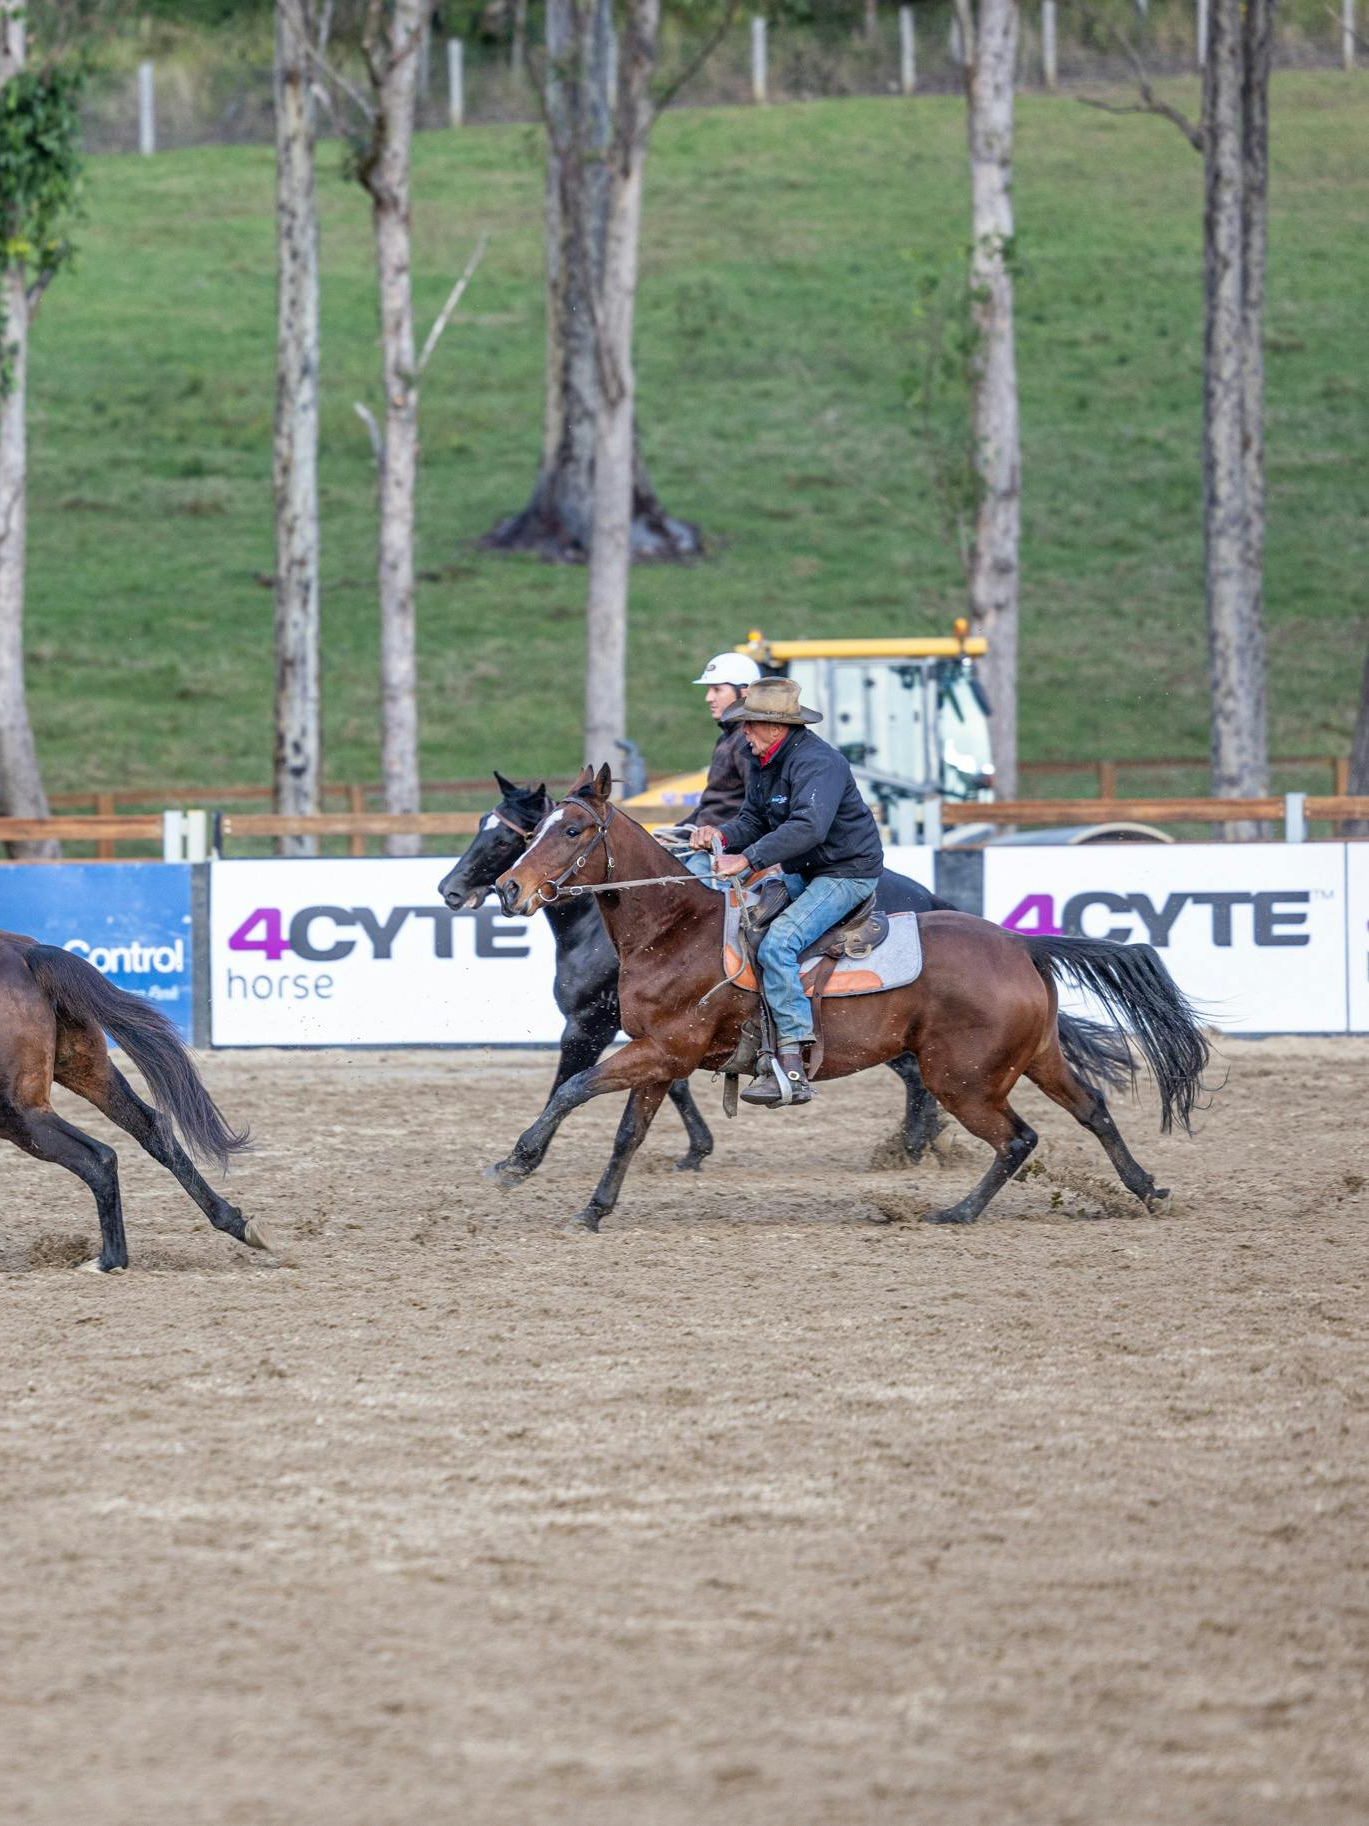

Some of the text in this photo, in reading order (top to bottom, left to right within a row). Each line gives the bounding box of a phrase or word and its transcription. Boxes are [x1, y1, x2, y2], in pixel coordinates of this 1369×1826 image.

[228, 905, 531, 962] 4CYTE
[1000, 891, 1311, 948] 4CYTE
[227, 968, 334, 1000] horse
